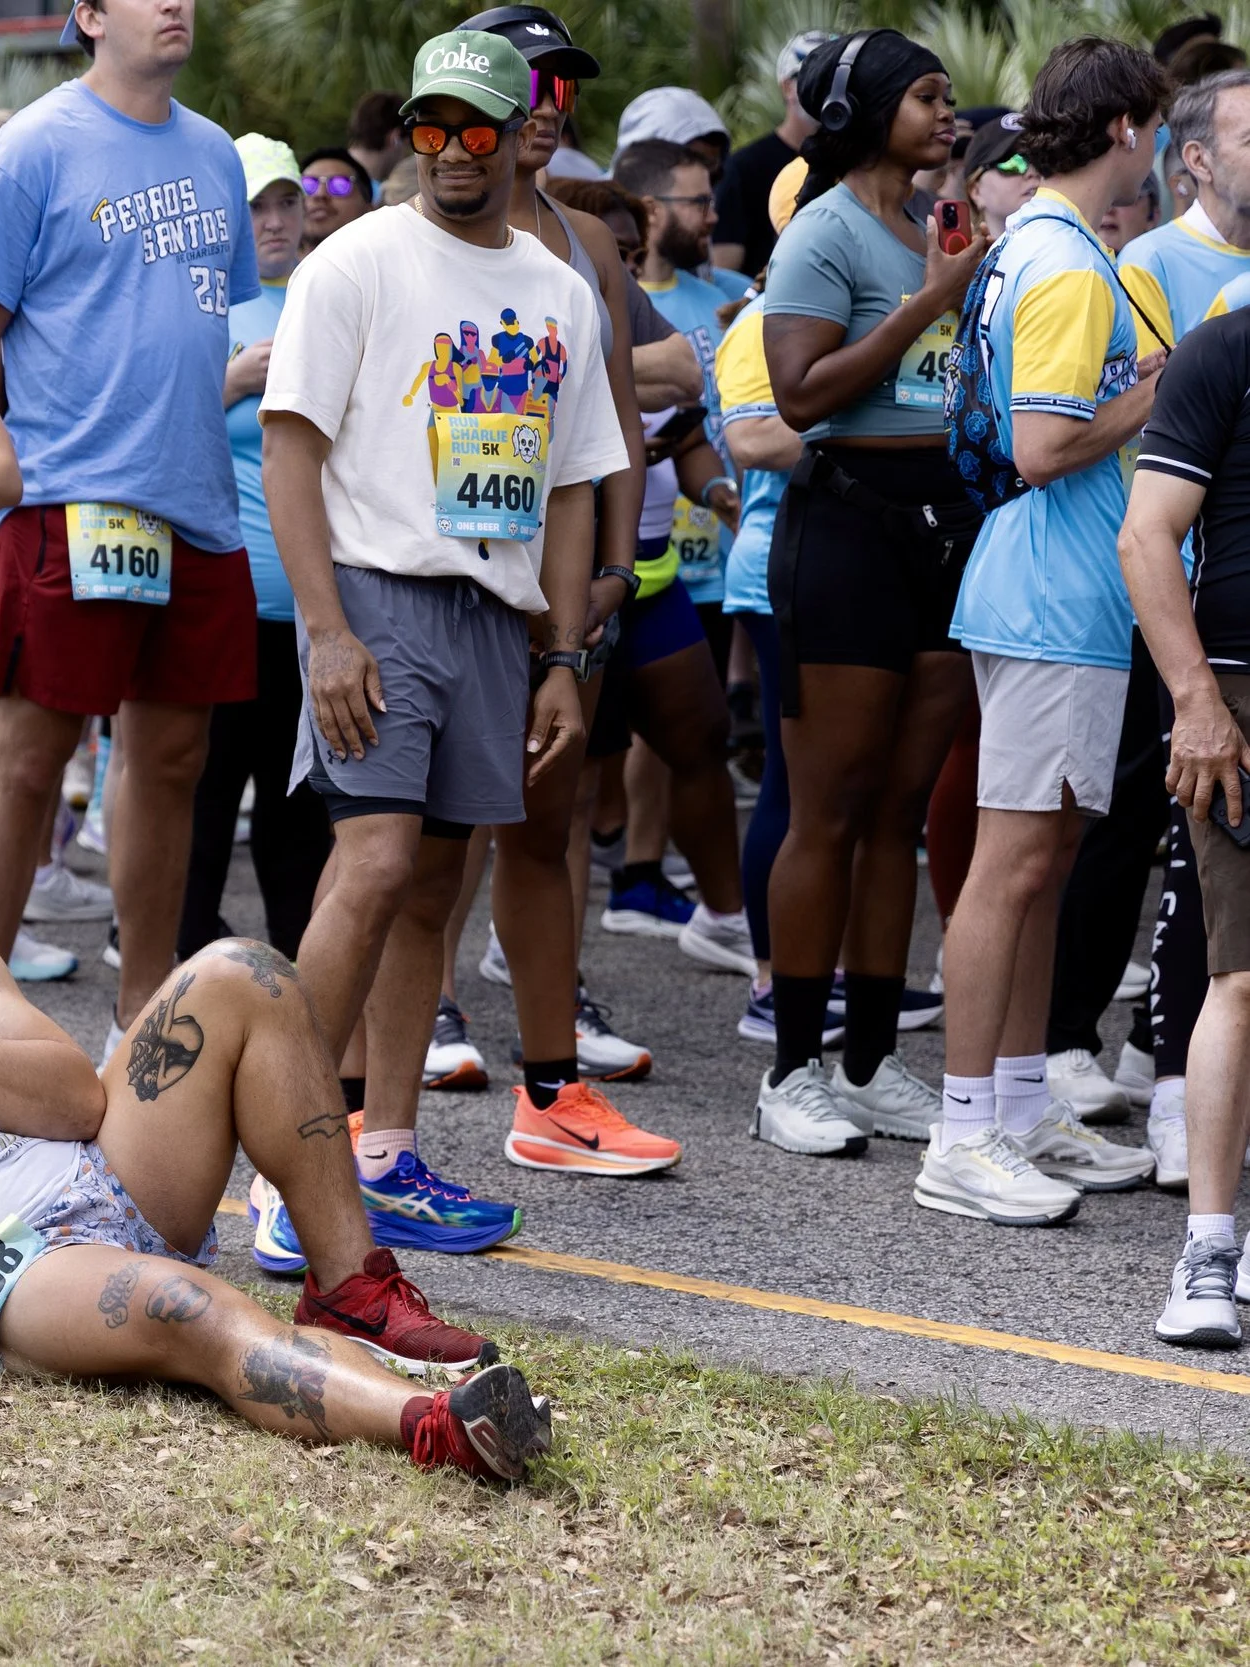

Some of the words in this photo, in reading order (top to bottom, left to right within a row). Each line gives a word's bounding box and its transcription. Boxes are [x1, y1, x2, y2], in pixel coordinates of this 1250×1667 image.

[426, 42, 490, 75] Coke
[99, 176, 198, 244] PERROS
[141, 207, 230, 265] SANTOS
[186, 244, 230, 262] CHARLESTO
[939, 324, 952, 337] 5K
[916, 350, 950, 384] 49
[448, 416, 479, 428] RUN
[451, 428, 509, 443] CHARLIE
[451, 441, 480, 455] RUN
[482, 442, 500, 456] 5K
[456, 472, 536, 513] 4460
[108, 518, 125, 530] 5K
[456, 521, 475, 531] ONE
[477, 521, 500, 532] BEER
[90, 543, 160, 579] 4160
[671, 537, 711, 563] 62
